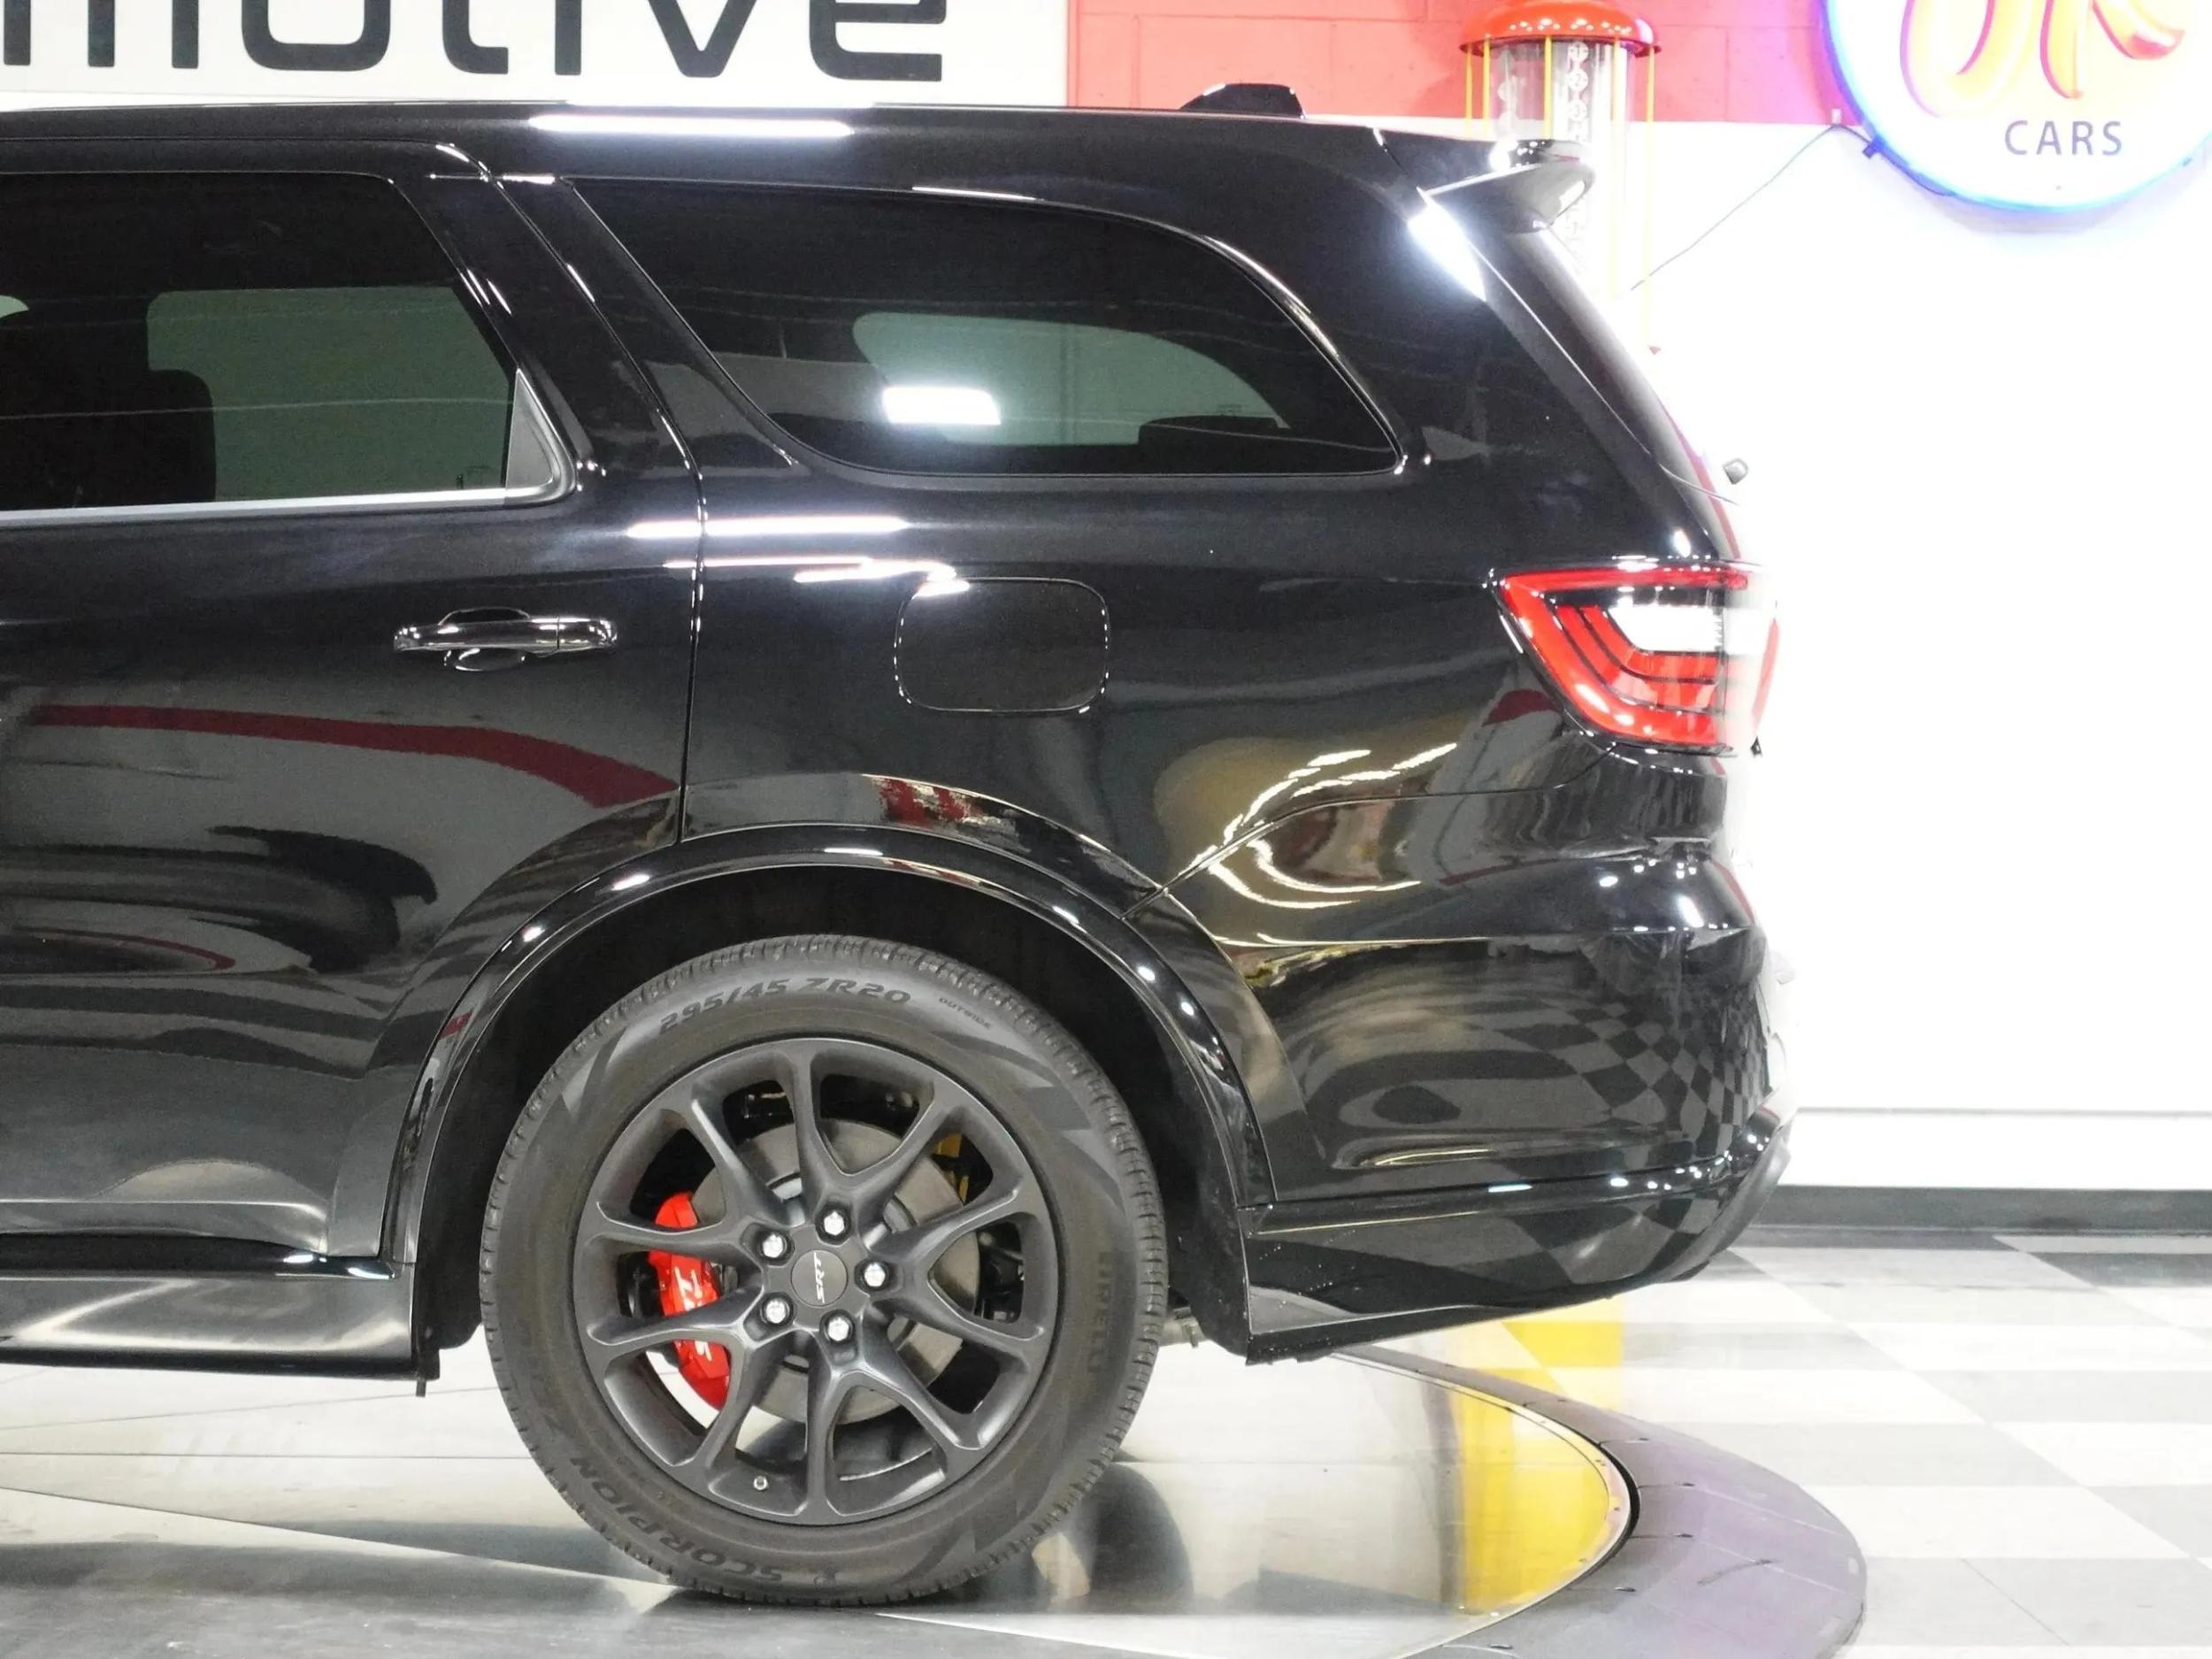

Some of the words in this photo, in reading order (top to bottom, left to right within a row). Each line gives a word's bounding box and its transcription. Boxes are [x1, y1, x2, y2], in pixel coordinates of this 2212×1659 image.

[2005, 120, 2123, 156] CARS
[659, 978, 792, 1034] 295/45
[798, 977, 911, 1004] ZR20
[813, 1252, 826, 1304] SRT
[569, 1457, 782, 1581] SCORPION
